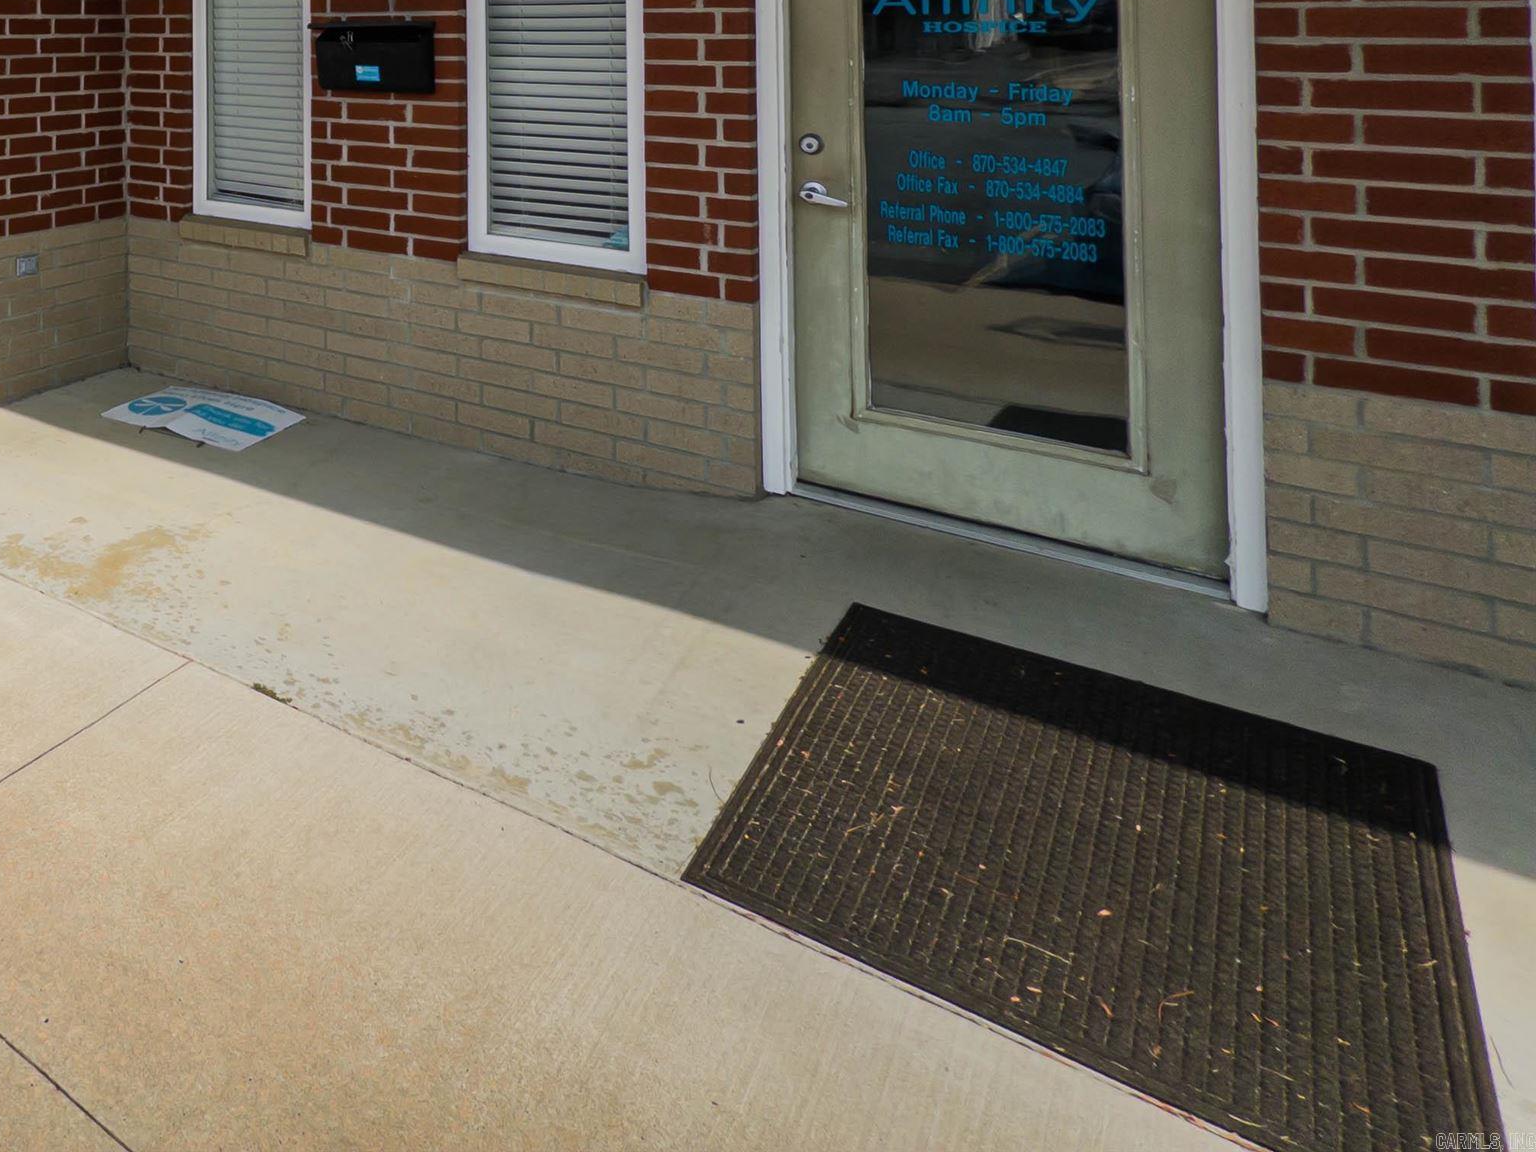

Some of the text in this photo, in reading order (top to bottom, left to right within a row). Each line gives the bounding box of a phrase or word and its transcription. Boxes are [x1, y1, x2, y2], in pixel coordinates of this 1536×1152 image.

[923, 20, 1047, 34] HOSPICE
[901, 80, 979, 102] Monday
[1008, 82, 1073, 105] Friday
[928, 103, 972, 122] 8am
[1000, 106, 1047, 128] 5pm
[908, 150, 946, 169] Office
[972, 153, 1068, 177] 870-534-4847
[896, 173, 933, 193] Office
[937, 176, 959, 195] Fax
[985, 179, 1085, 205] 870-534-4884
[880, 200, 925, 222] Referral
[930, 204, 967, 225] Phone
[993, 210, 1106, 238] 1-800-575-2083
[887, 224, 933, 246] Referral
[937, 229, 959, 249] Fax
[986, 234, 1098, 263] 1-800-575-2083
